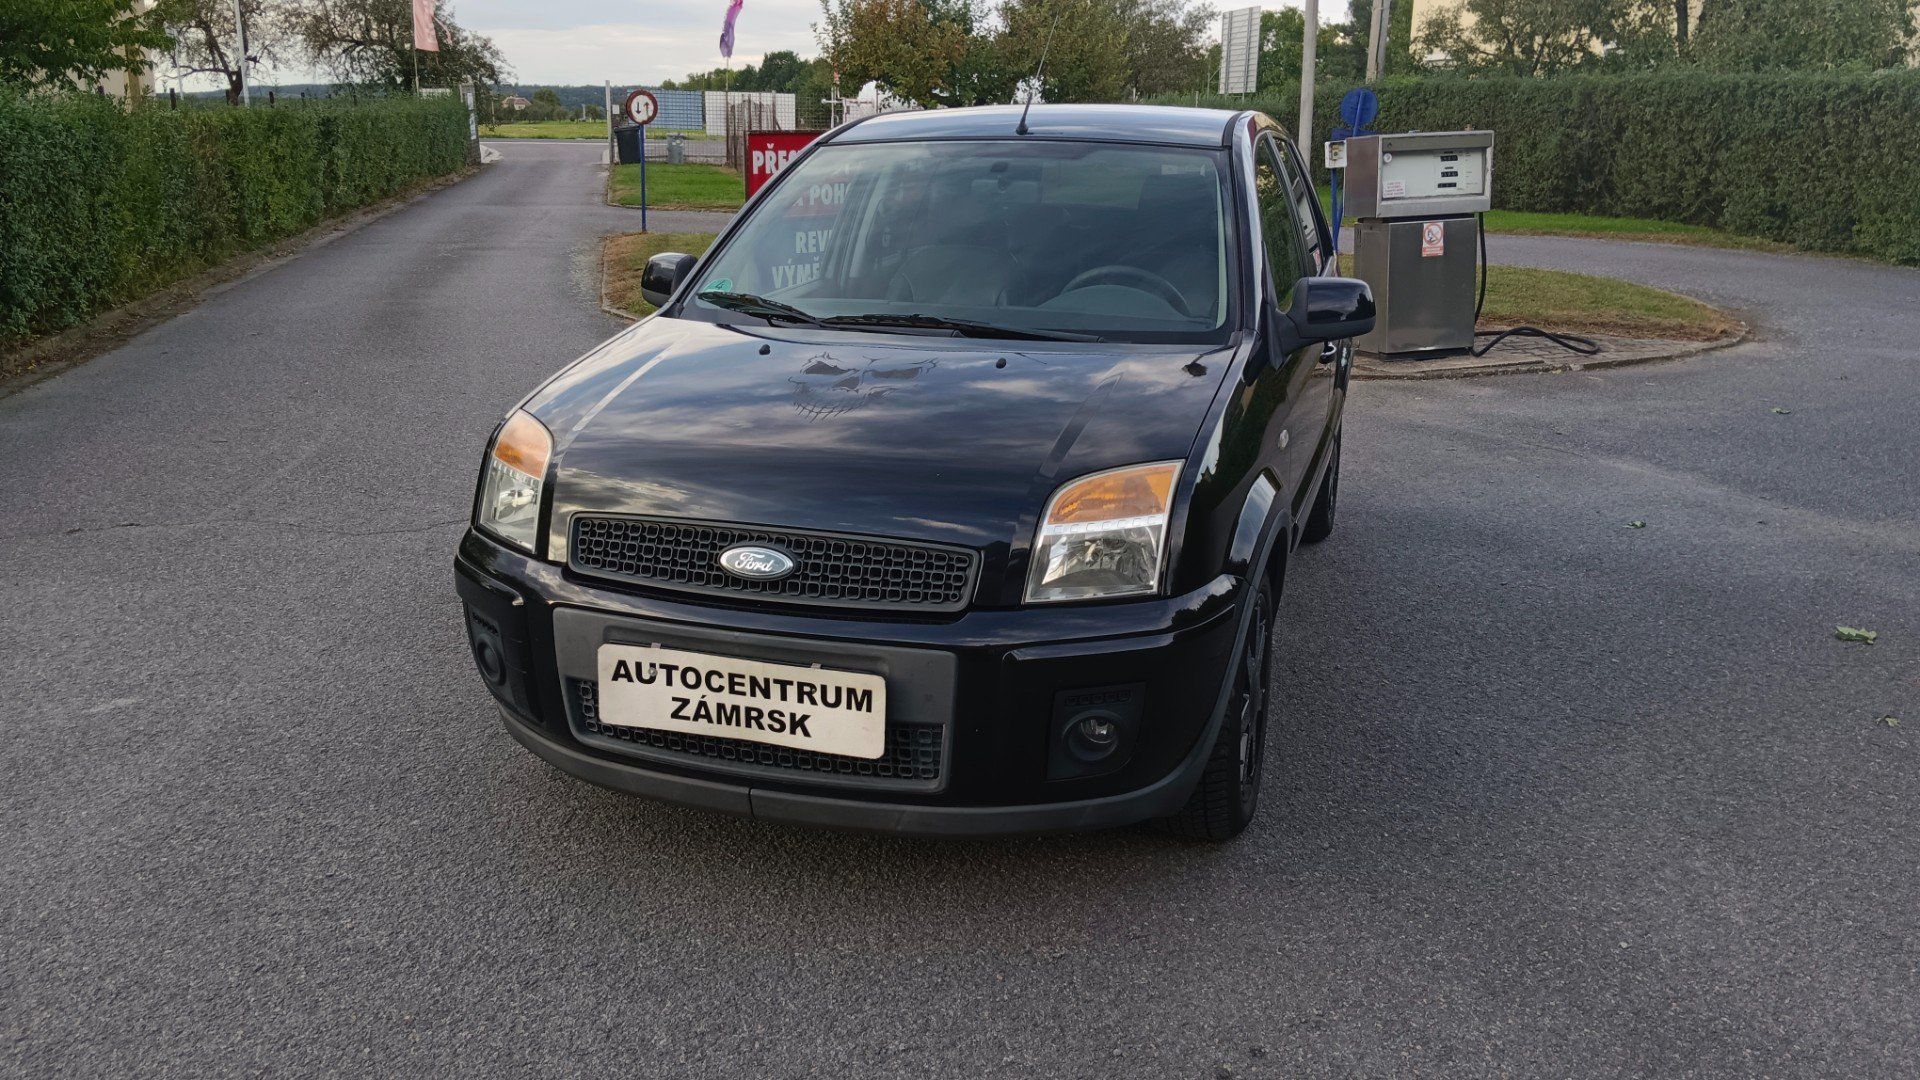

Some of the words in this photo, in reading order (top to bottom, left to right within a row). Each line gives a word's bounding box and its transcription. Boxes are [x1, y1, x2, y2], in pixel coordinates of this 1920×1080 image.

[808, 182, 851, 206] POH
[734, 552, 775, 572] Ford
[611, 659, 873, 713] AUTOCENTRUM
[670, 694, 812, 738] ZÁMRSK
